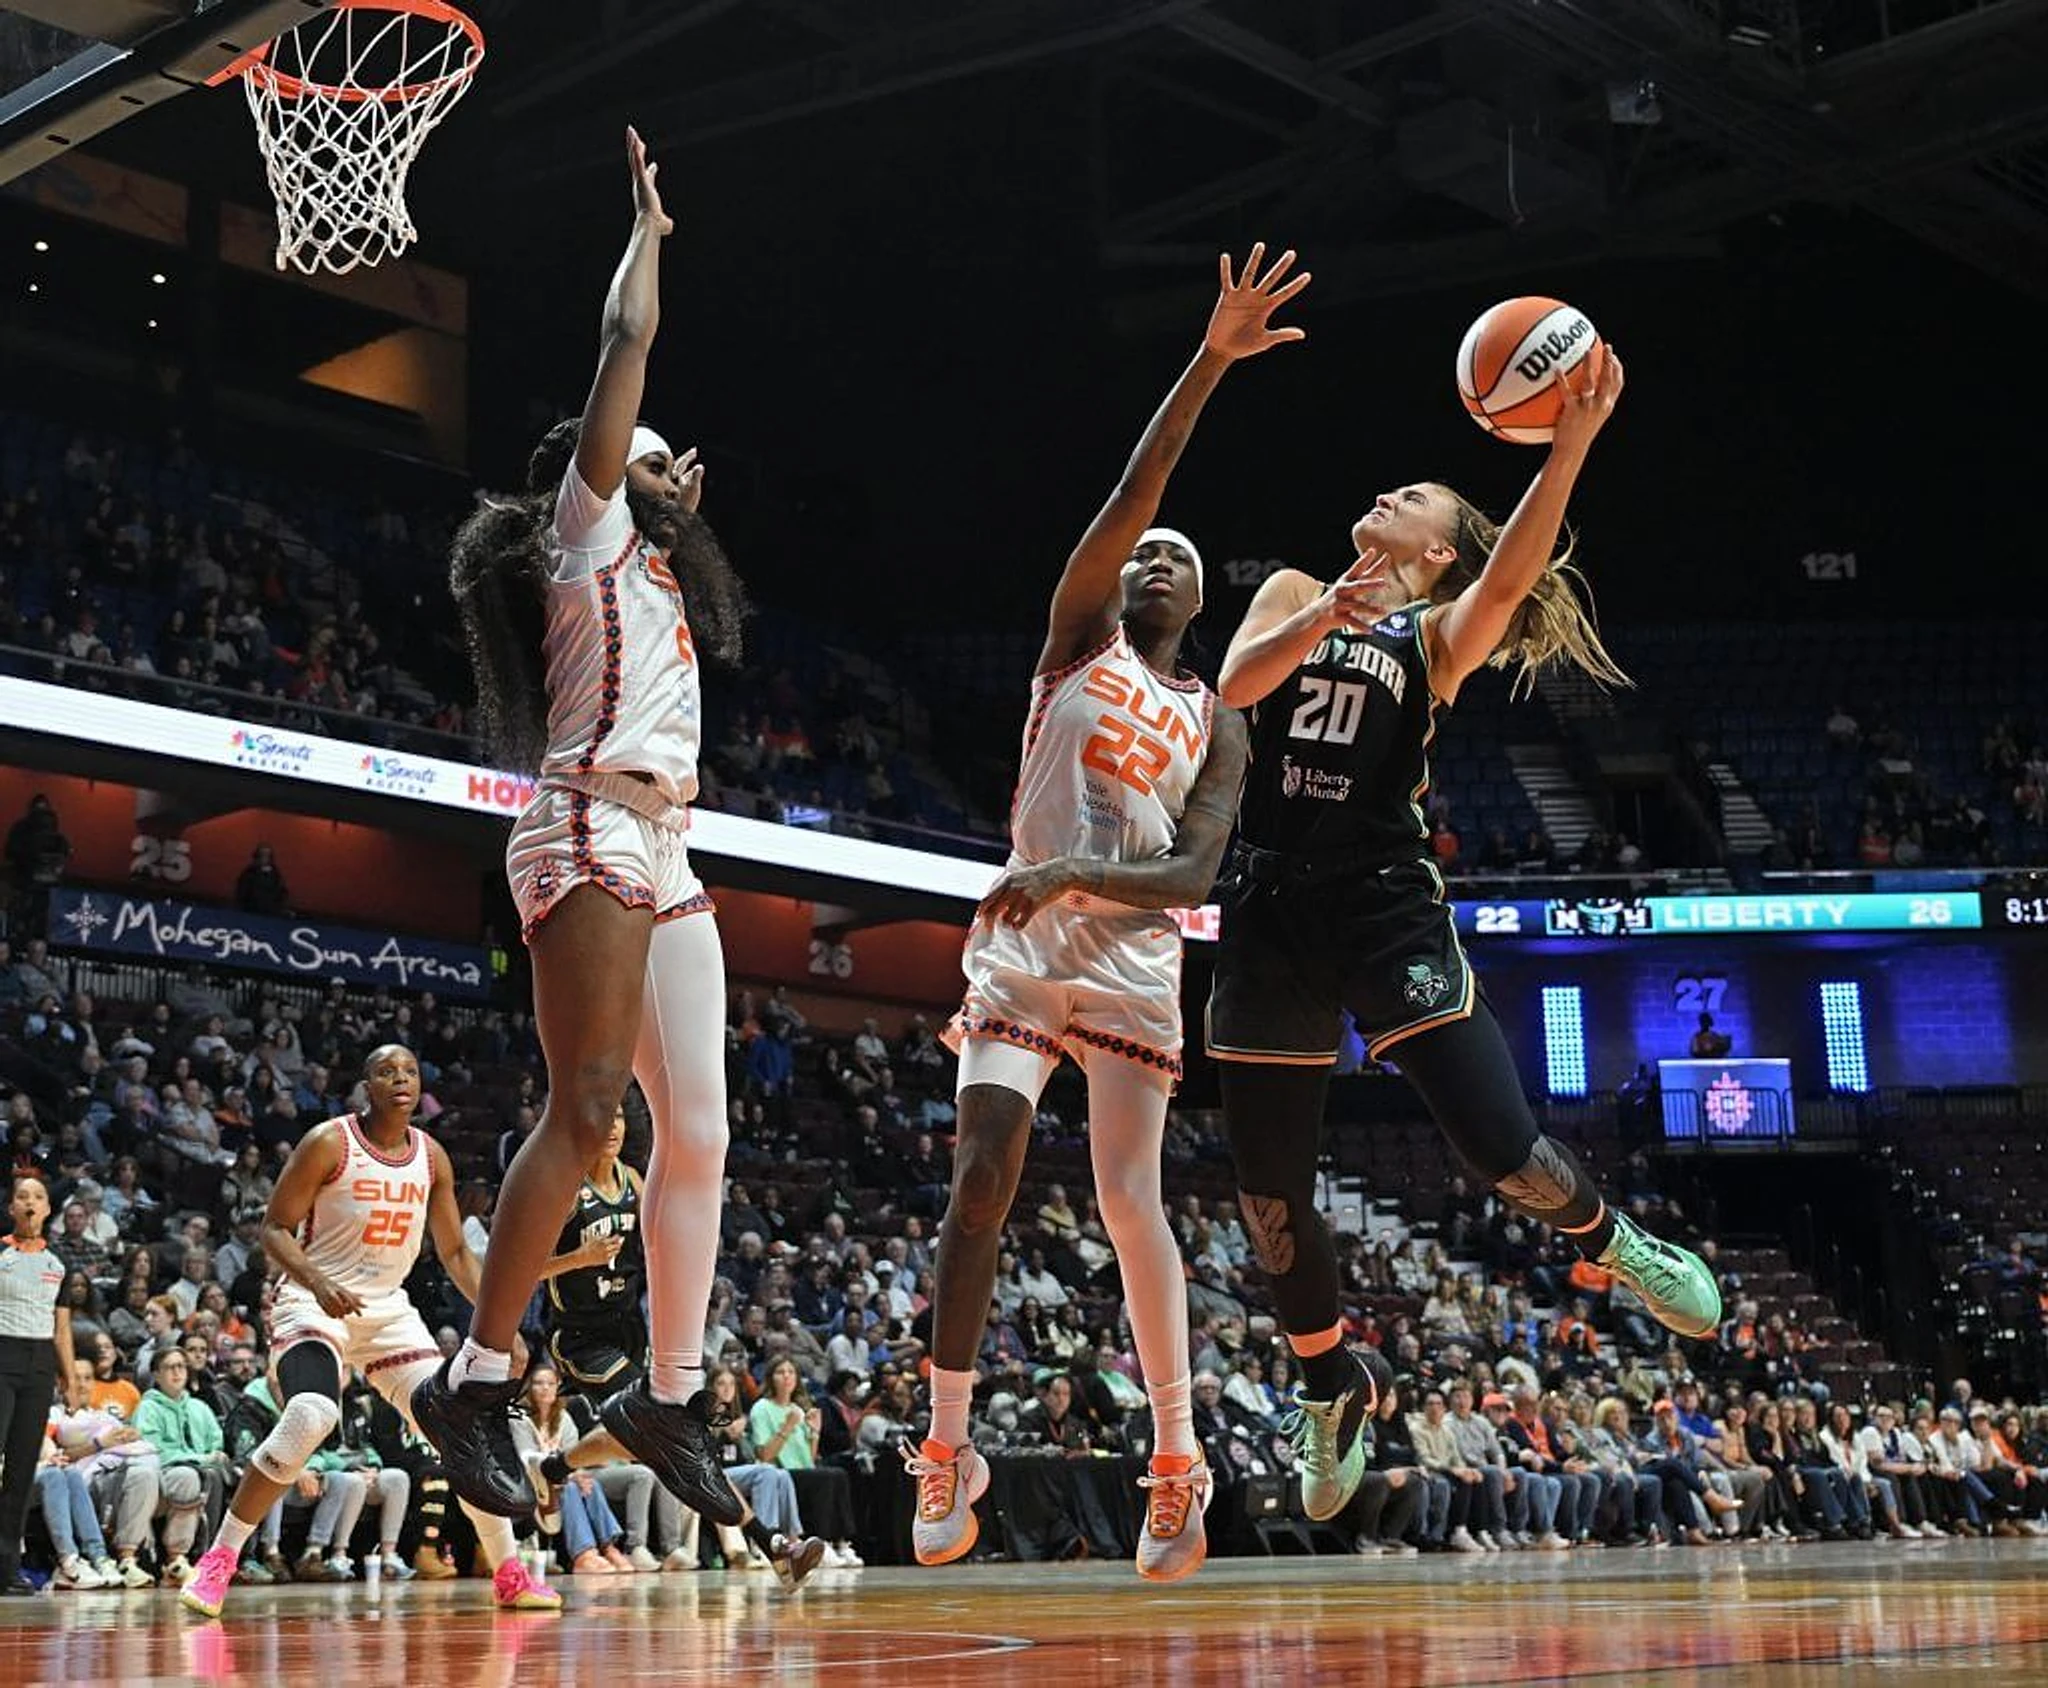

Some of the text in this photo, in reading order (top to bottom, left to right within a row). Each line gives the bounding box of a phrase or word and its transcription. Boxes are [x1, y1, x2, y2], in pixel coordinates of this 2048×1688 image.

[1515, 319, 1591, 381] Wilson
[1801, 552, 1857, 580] 121
[1083, 665, 1201, 761] SUN
[1288, 676, 1368, 745] 20
[1081, 714, 1172, 797] 22
[1305, 767, 1353, 788] Liberty
[130, 835, 192, 882] 25
[1475, 906, 1521, 933] 22
[1664, 899, 1953, 928] LIBERTY 26
[2005, 898, 2048, 923] 8:1
[111, 899, 482, 987] Mohegan Sun Arena
[808, 940, 853, 978] 26
[1675, 977, 1728, 1012] 27
[352, 1179, 426, 1203] SUN
[361, 1210, 413, 1247] 25
